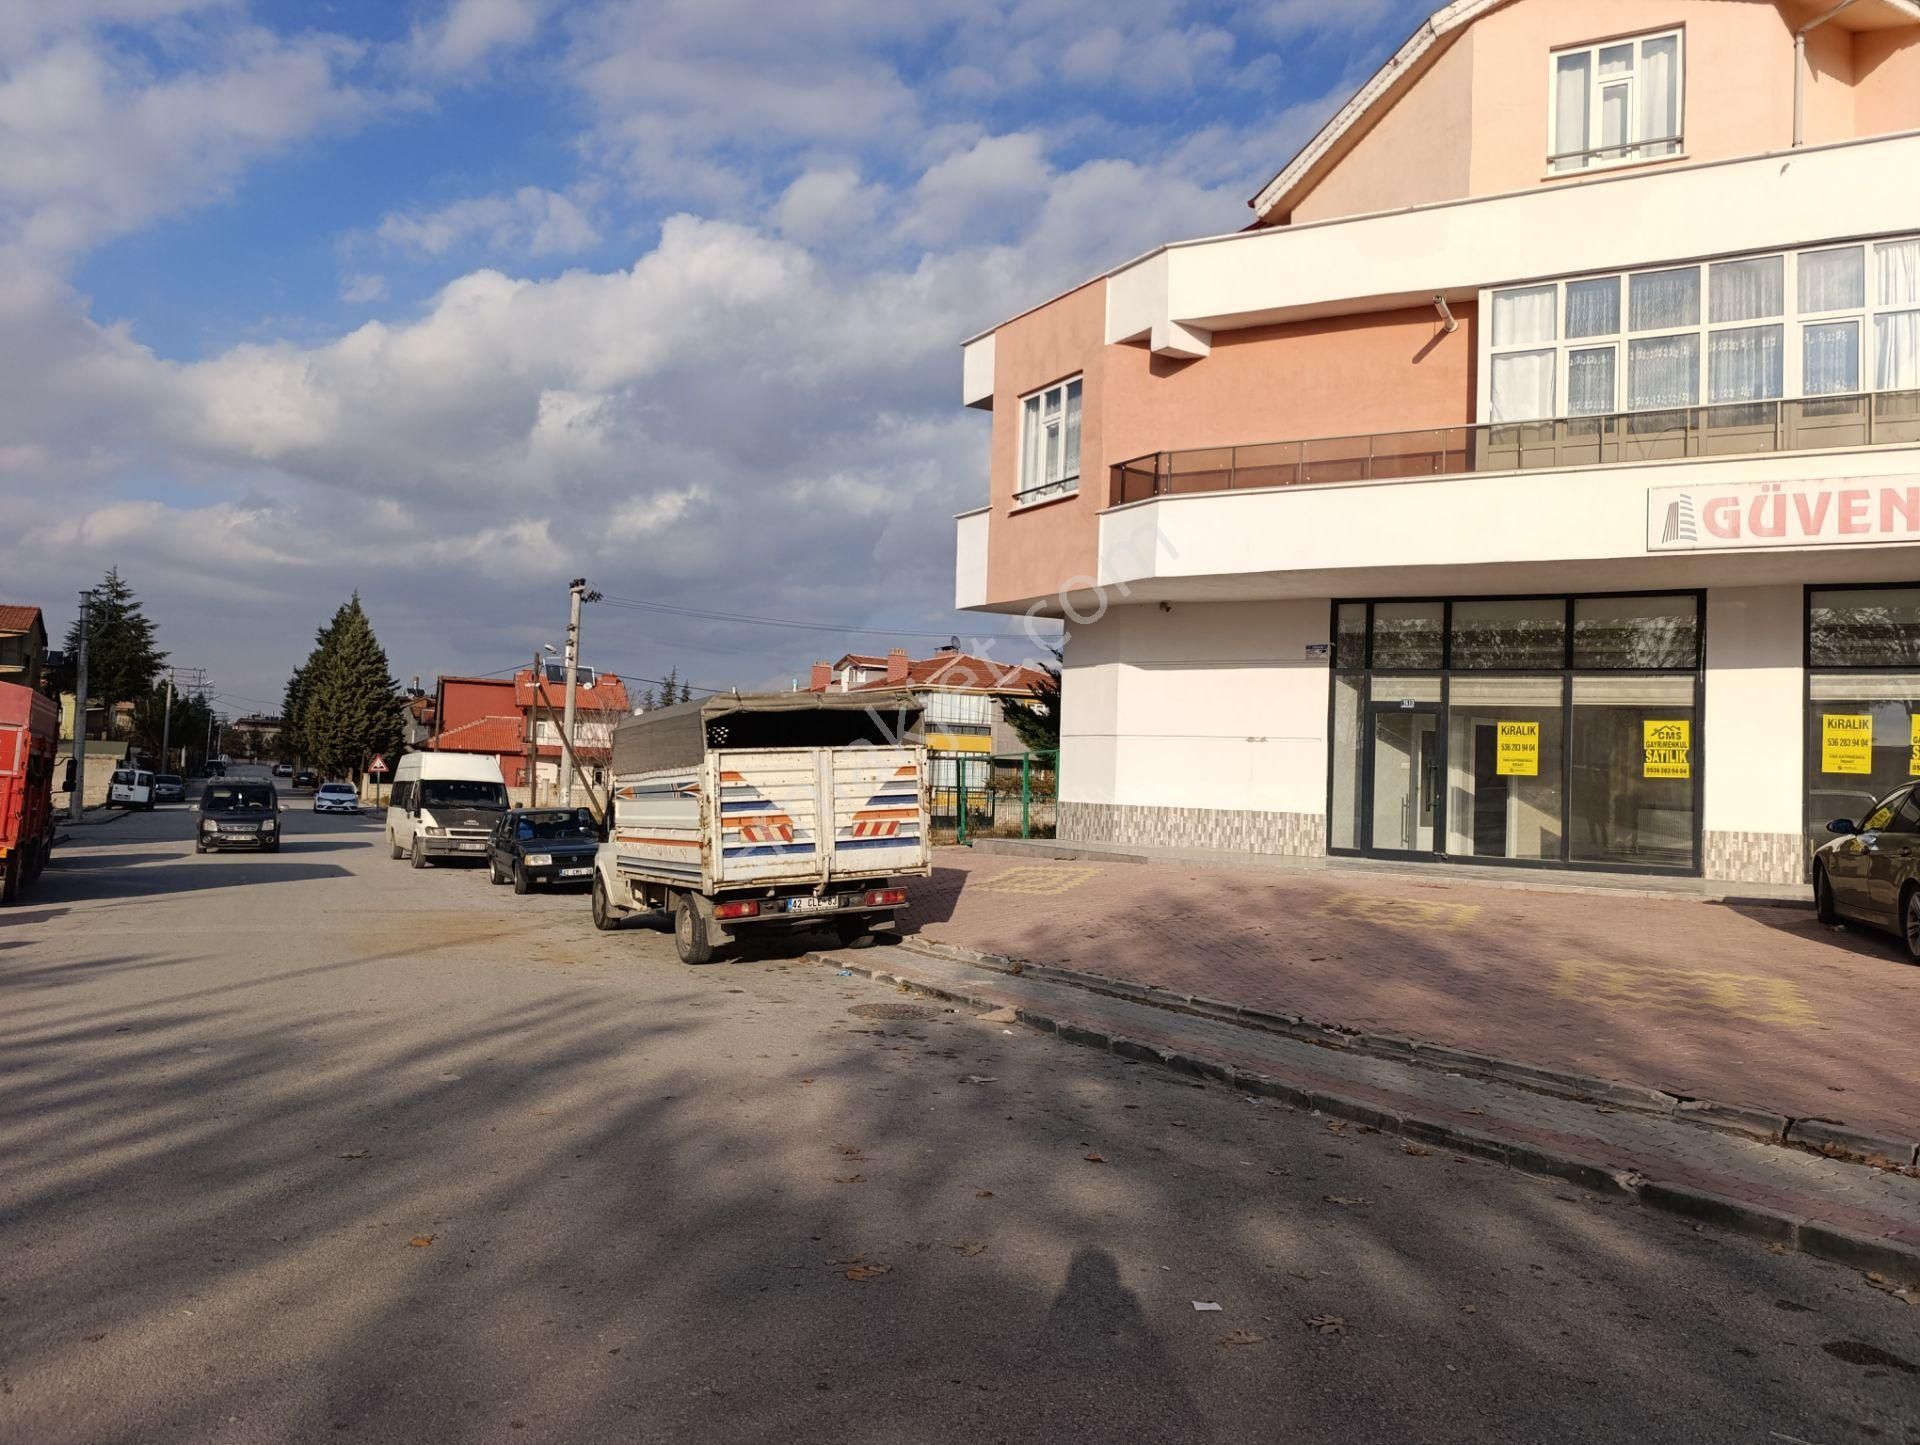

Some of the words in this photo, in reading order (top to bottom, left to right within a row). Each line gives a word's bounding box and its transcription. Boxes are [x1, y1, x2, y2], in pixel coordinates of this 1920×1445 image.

[1702, 483, 1920, 539] GÜVEN
[1658, 731, 1682, 740] CMS
[792, 899, 802, 908] 42
